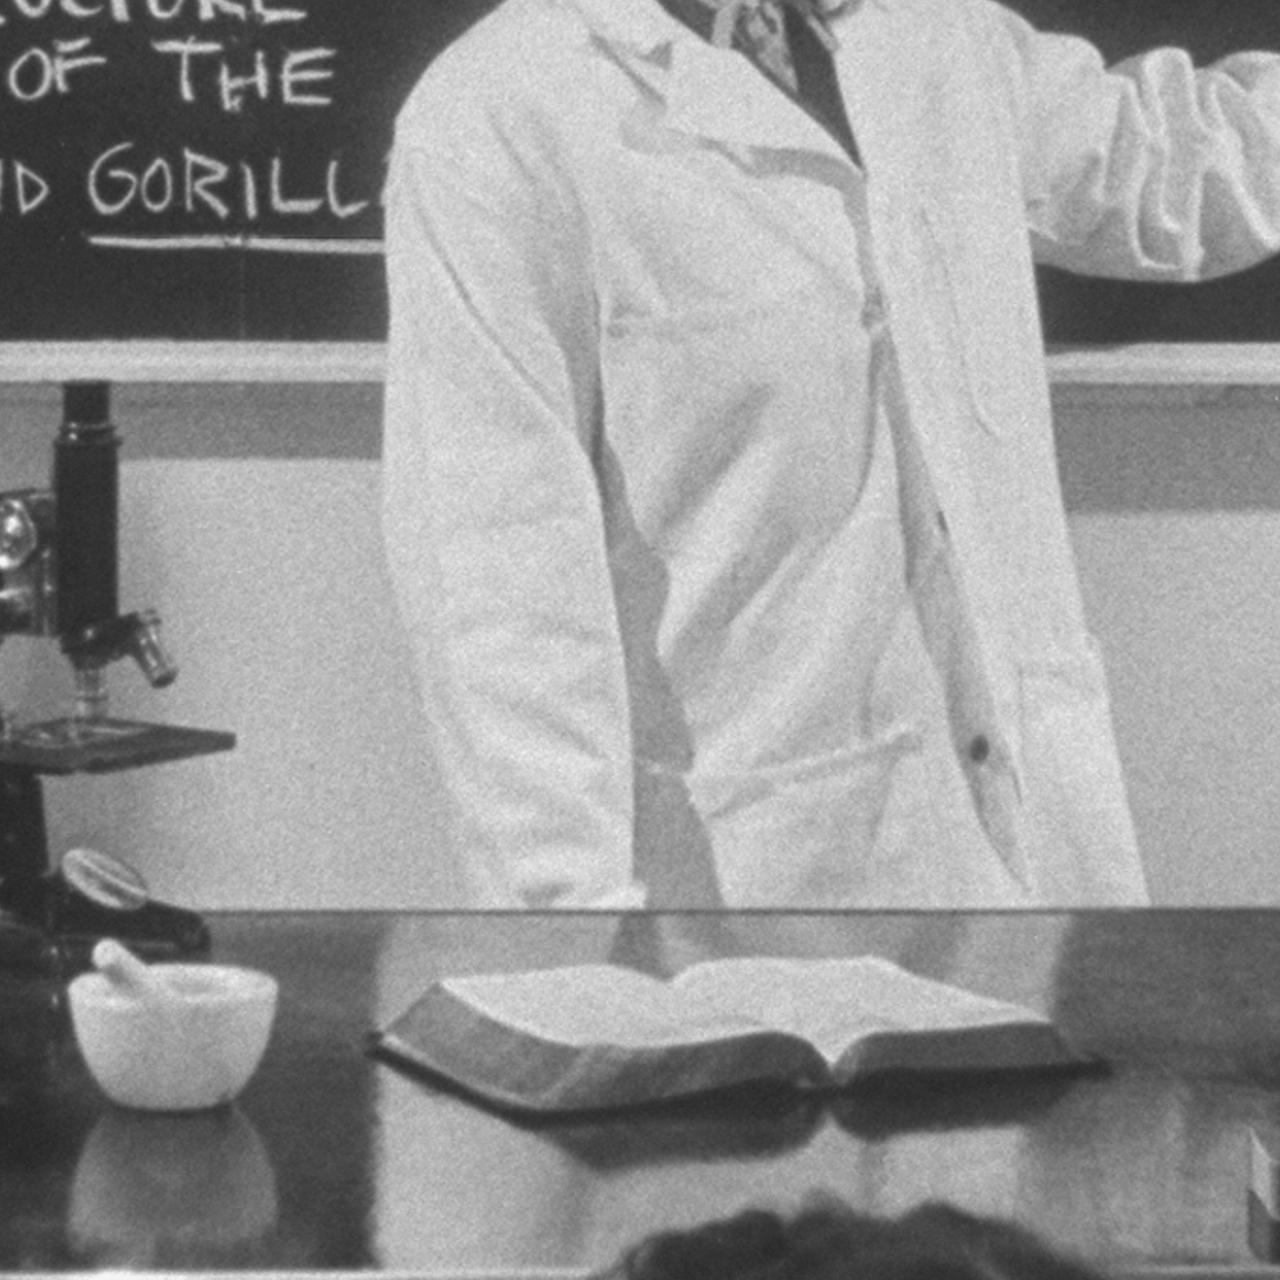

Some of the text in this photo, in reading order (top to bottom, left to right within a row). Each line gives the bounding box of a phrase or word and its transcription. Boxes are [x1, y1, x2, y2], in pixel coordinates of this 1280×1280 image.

[7, 36, 107, 101] OF
[152, 35, 335, 111] THE
[87, 142, 382, 219] GORILL
